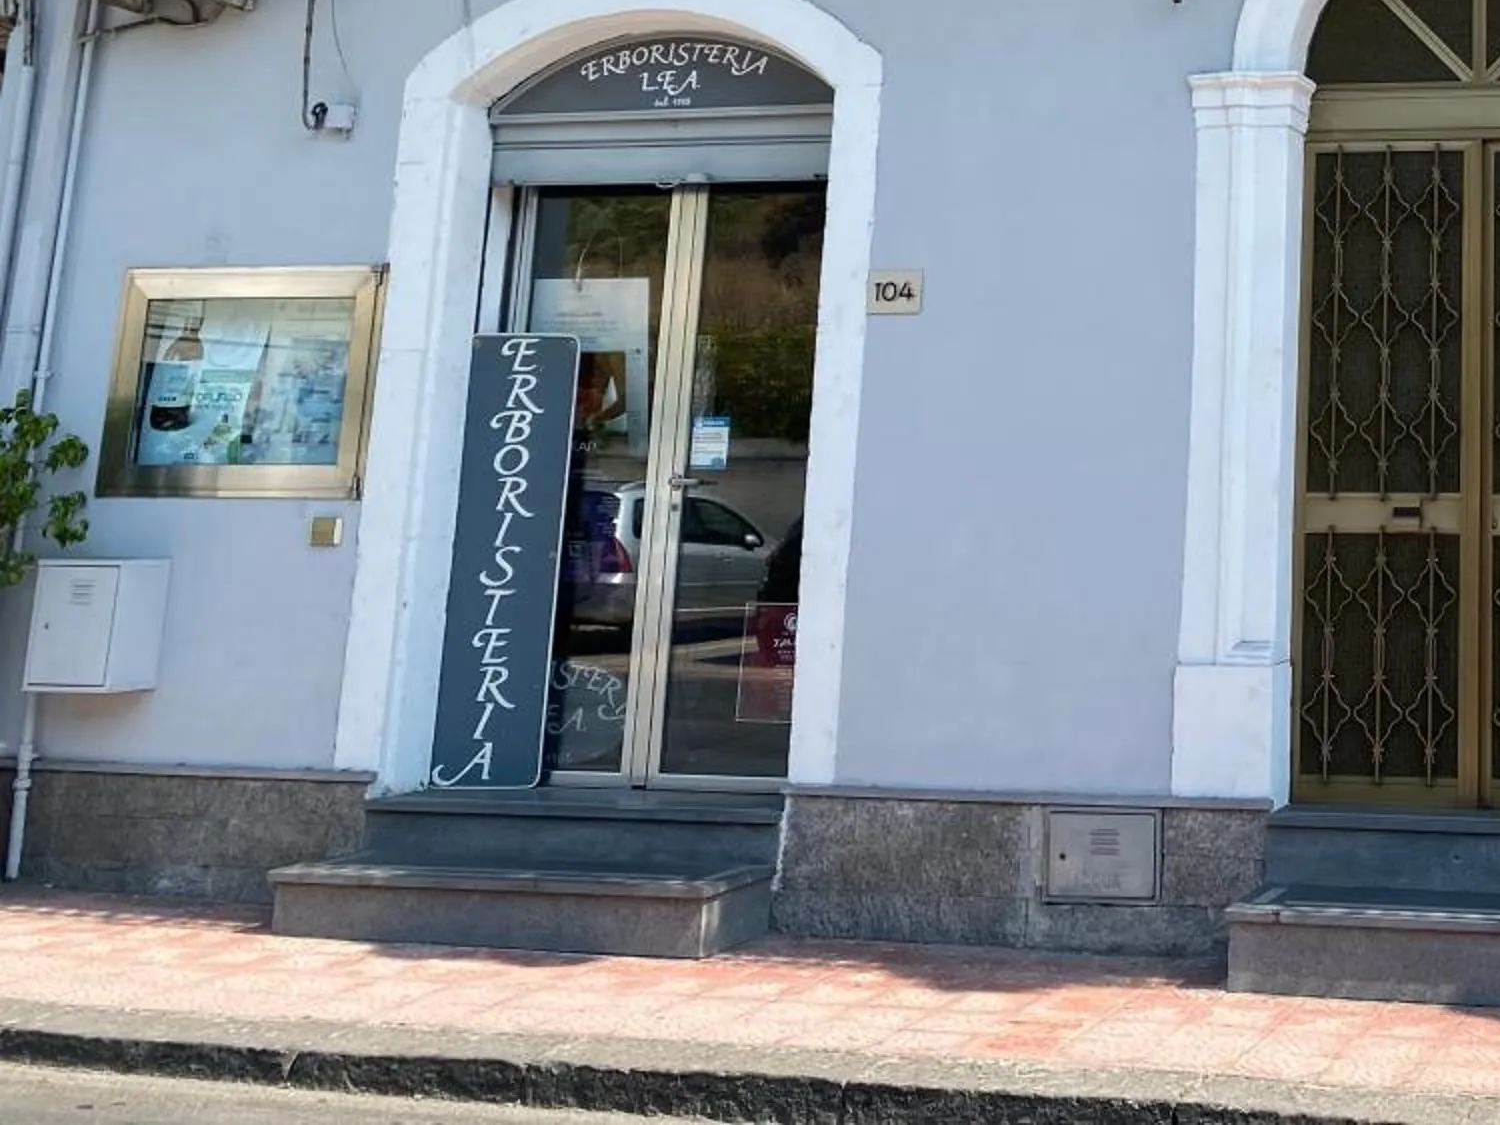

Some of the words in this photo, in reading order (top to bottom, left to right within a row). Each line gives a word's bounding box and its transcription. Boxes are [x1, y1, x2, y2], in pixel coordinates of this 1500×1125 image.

[580, 42, 769, 82] ERBORISTERIA
[875, 281, 914, 302] 104
[432, 338, 544, 786] ERBORISTERIA
